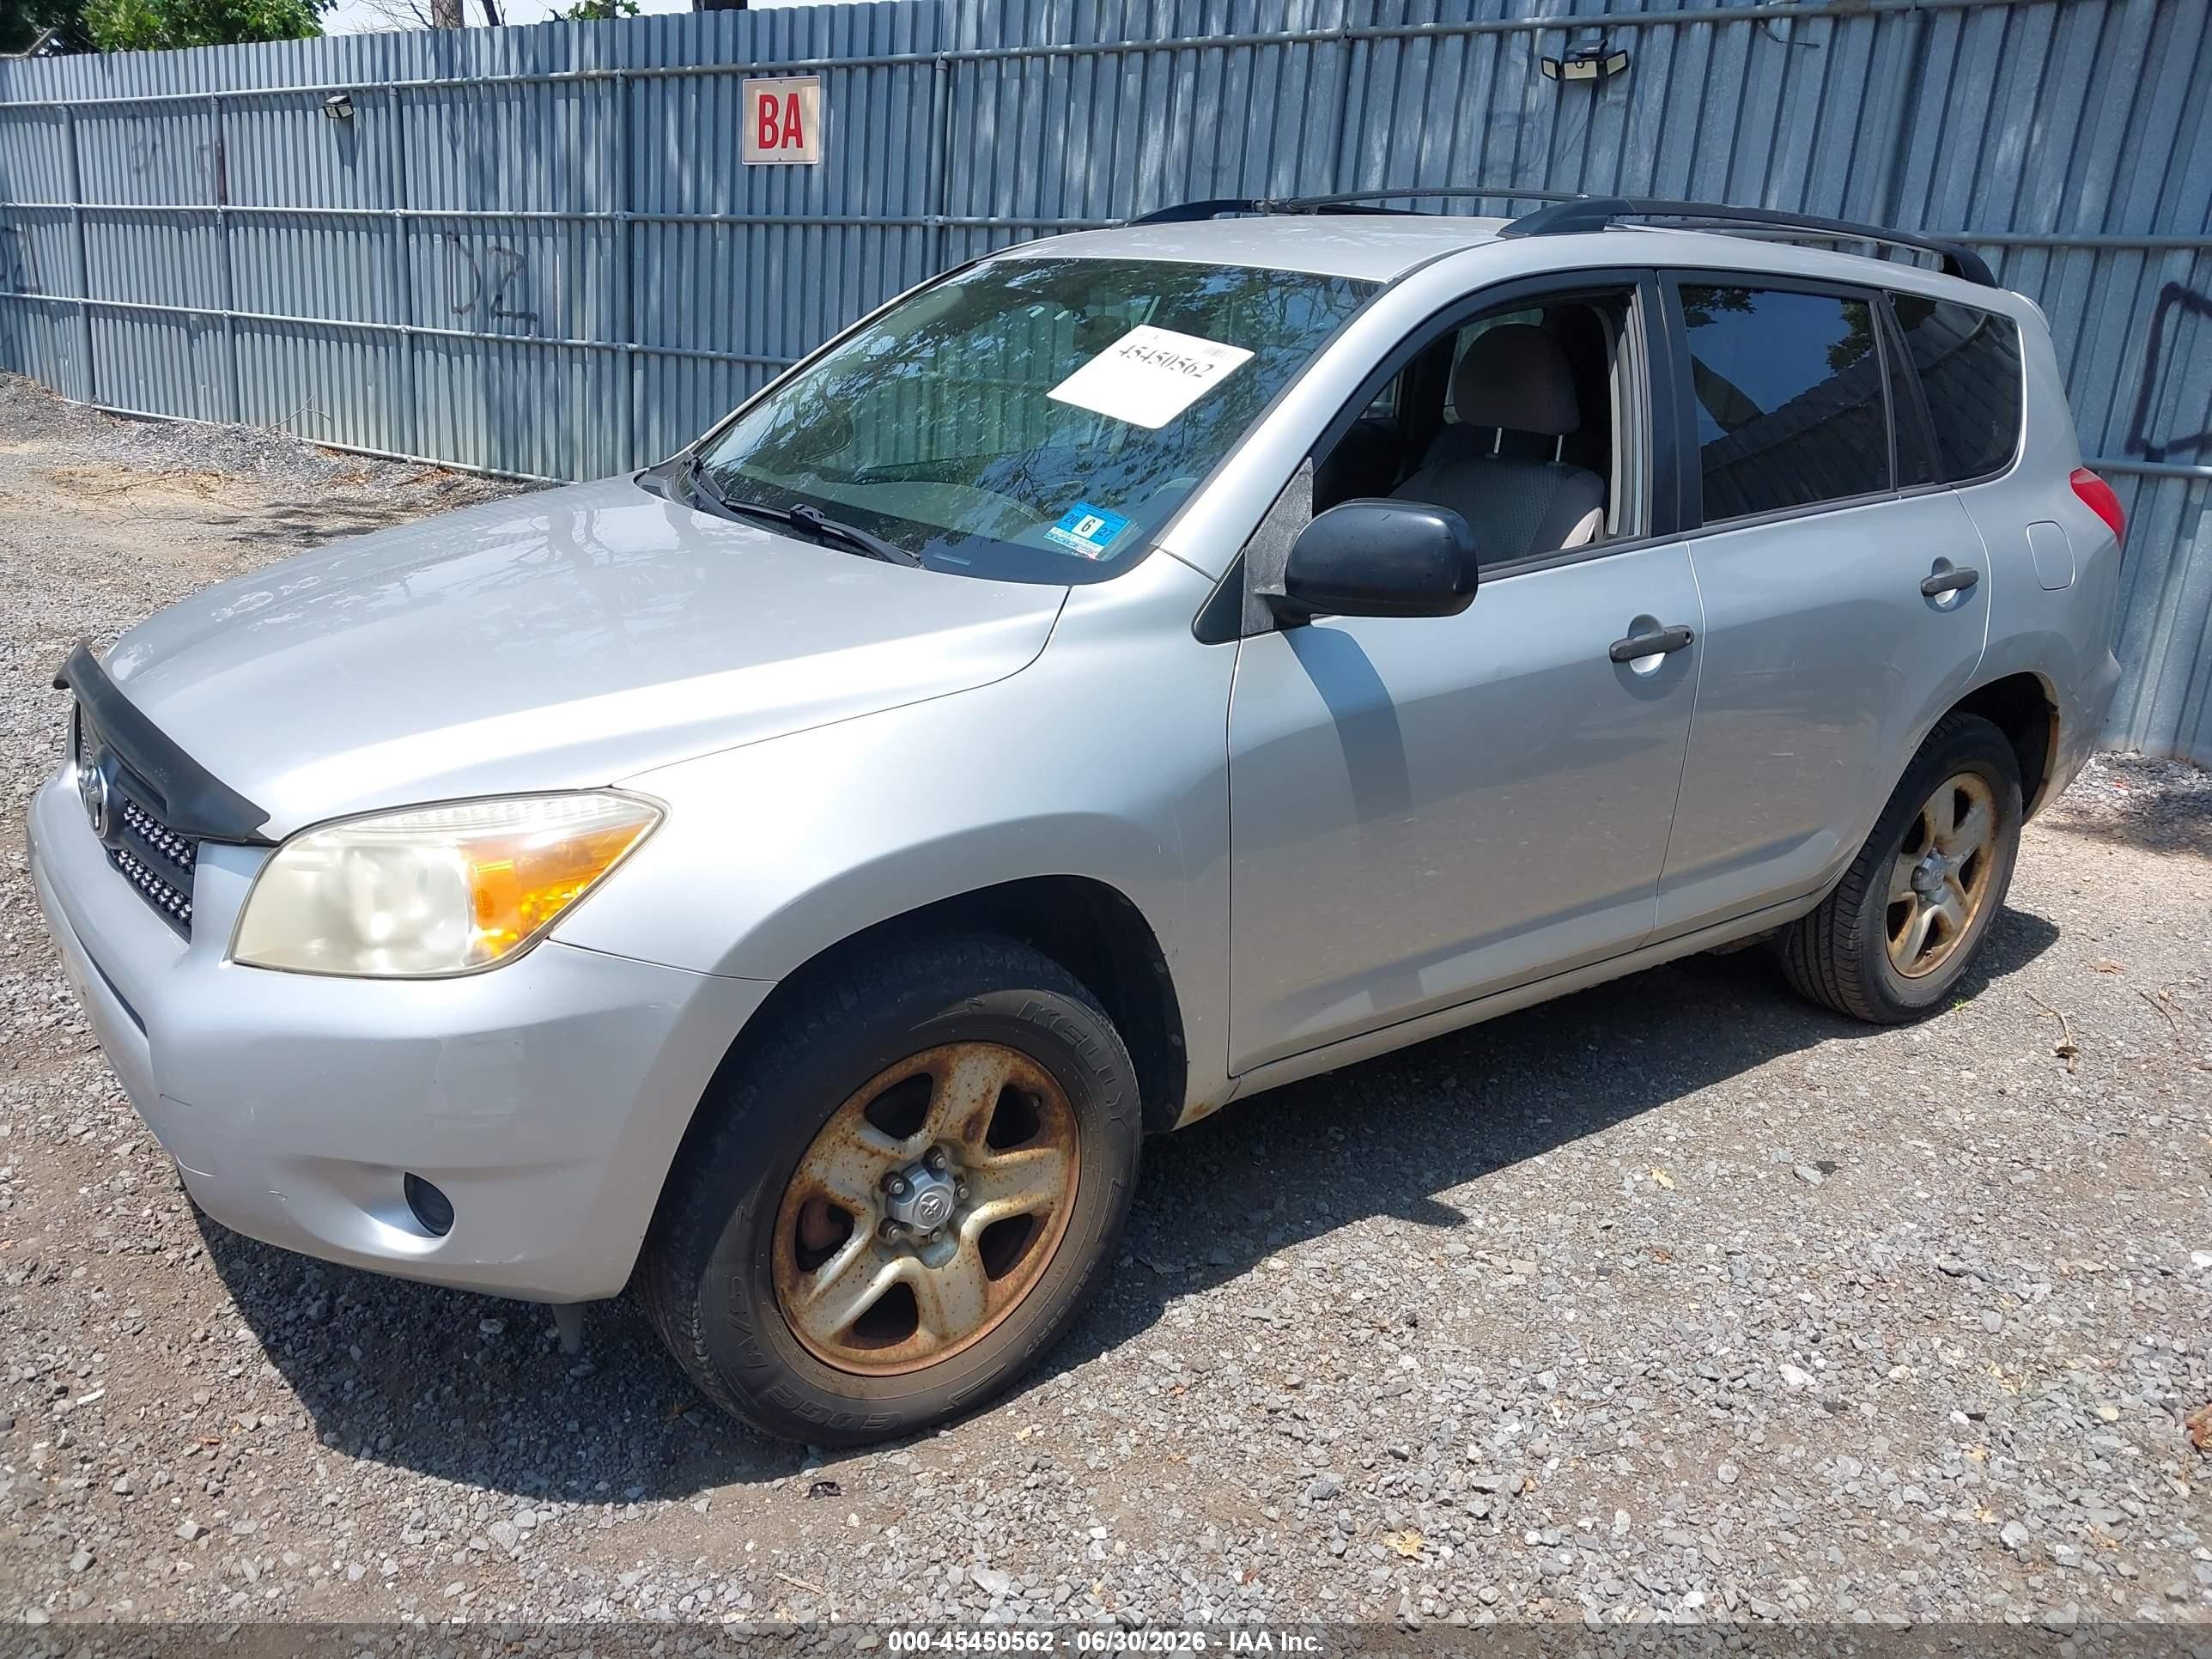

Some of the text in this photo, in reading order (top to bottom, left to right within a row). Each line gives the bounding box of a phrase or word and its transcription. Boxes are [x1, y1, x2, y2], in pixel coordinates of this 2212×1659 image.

[758, 93, 804, 149] BA
[1119, 344, 1215, 378] 45450562
[1064, 514, 1114, 538] 20 6 27
[1016, 998, 1127, 1127] KELLY
[763, 1382, 902, 1432] EDGE
